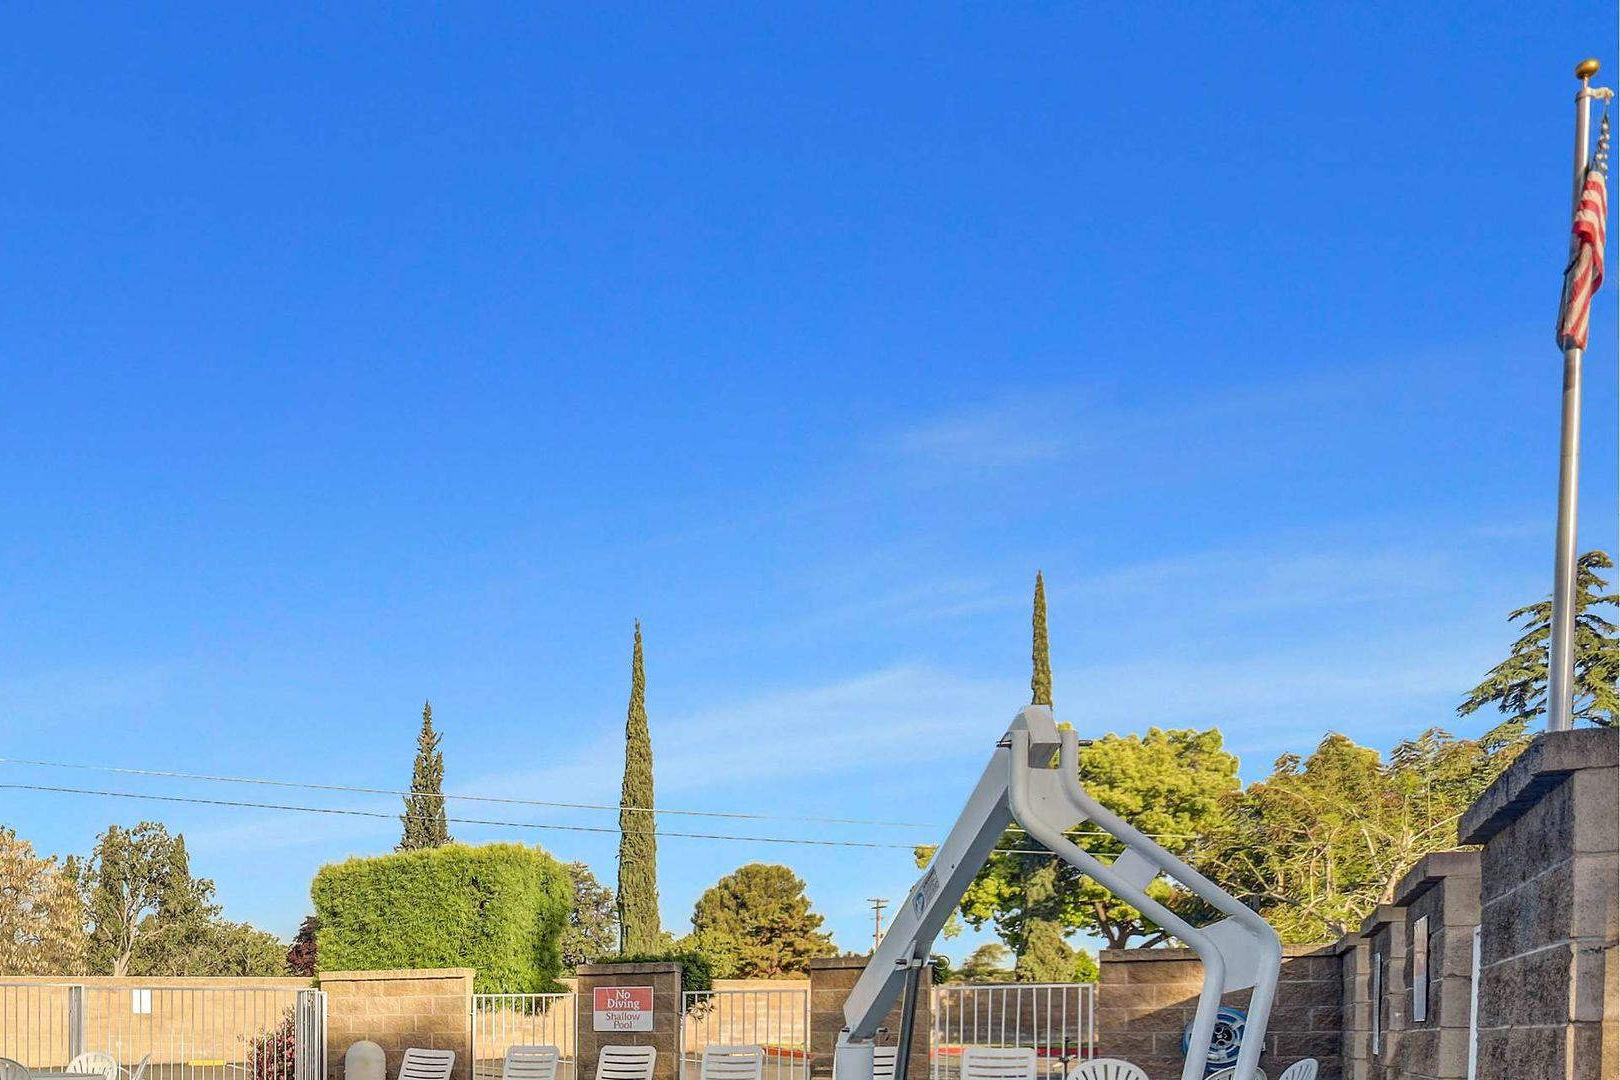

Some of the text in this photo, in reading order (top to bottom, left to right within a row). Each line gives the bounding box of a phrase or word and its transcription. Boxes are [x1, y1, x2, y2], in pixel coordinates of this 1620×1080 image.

[616, 989, 631, 1000] No
[607, 999, 640, 1010] Diving
[606, 1012, 640, 1021] Shallow
[613, 1021, 633, 1029] Pool
